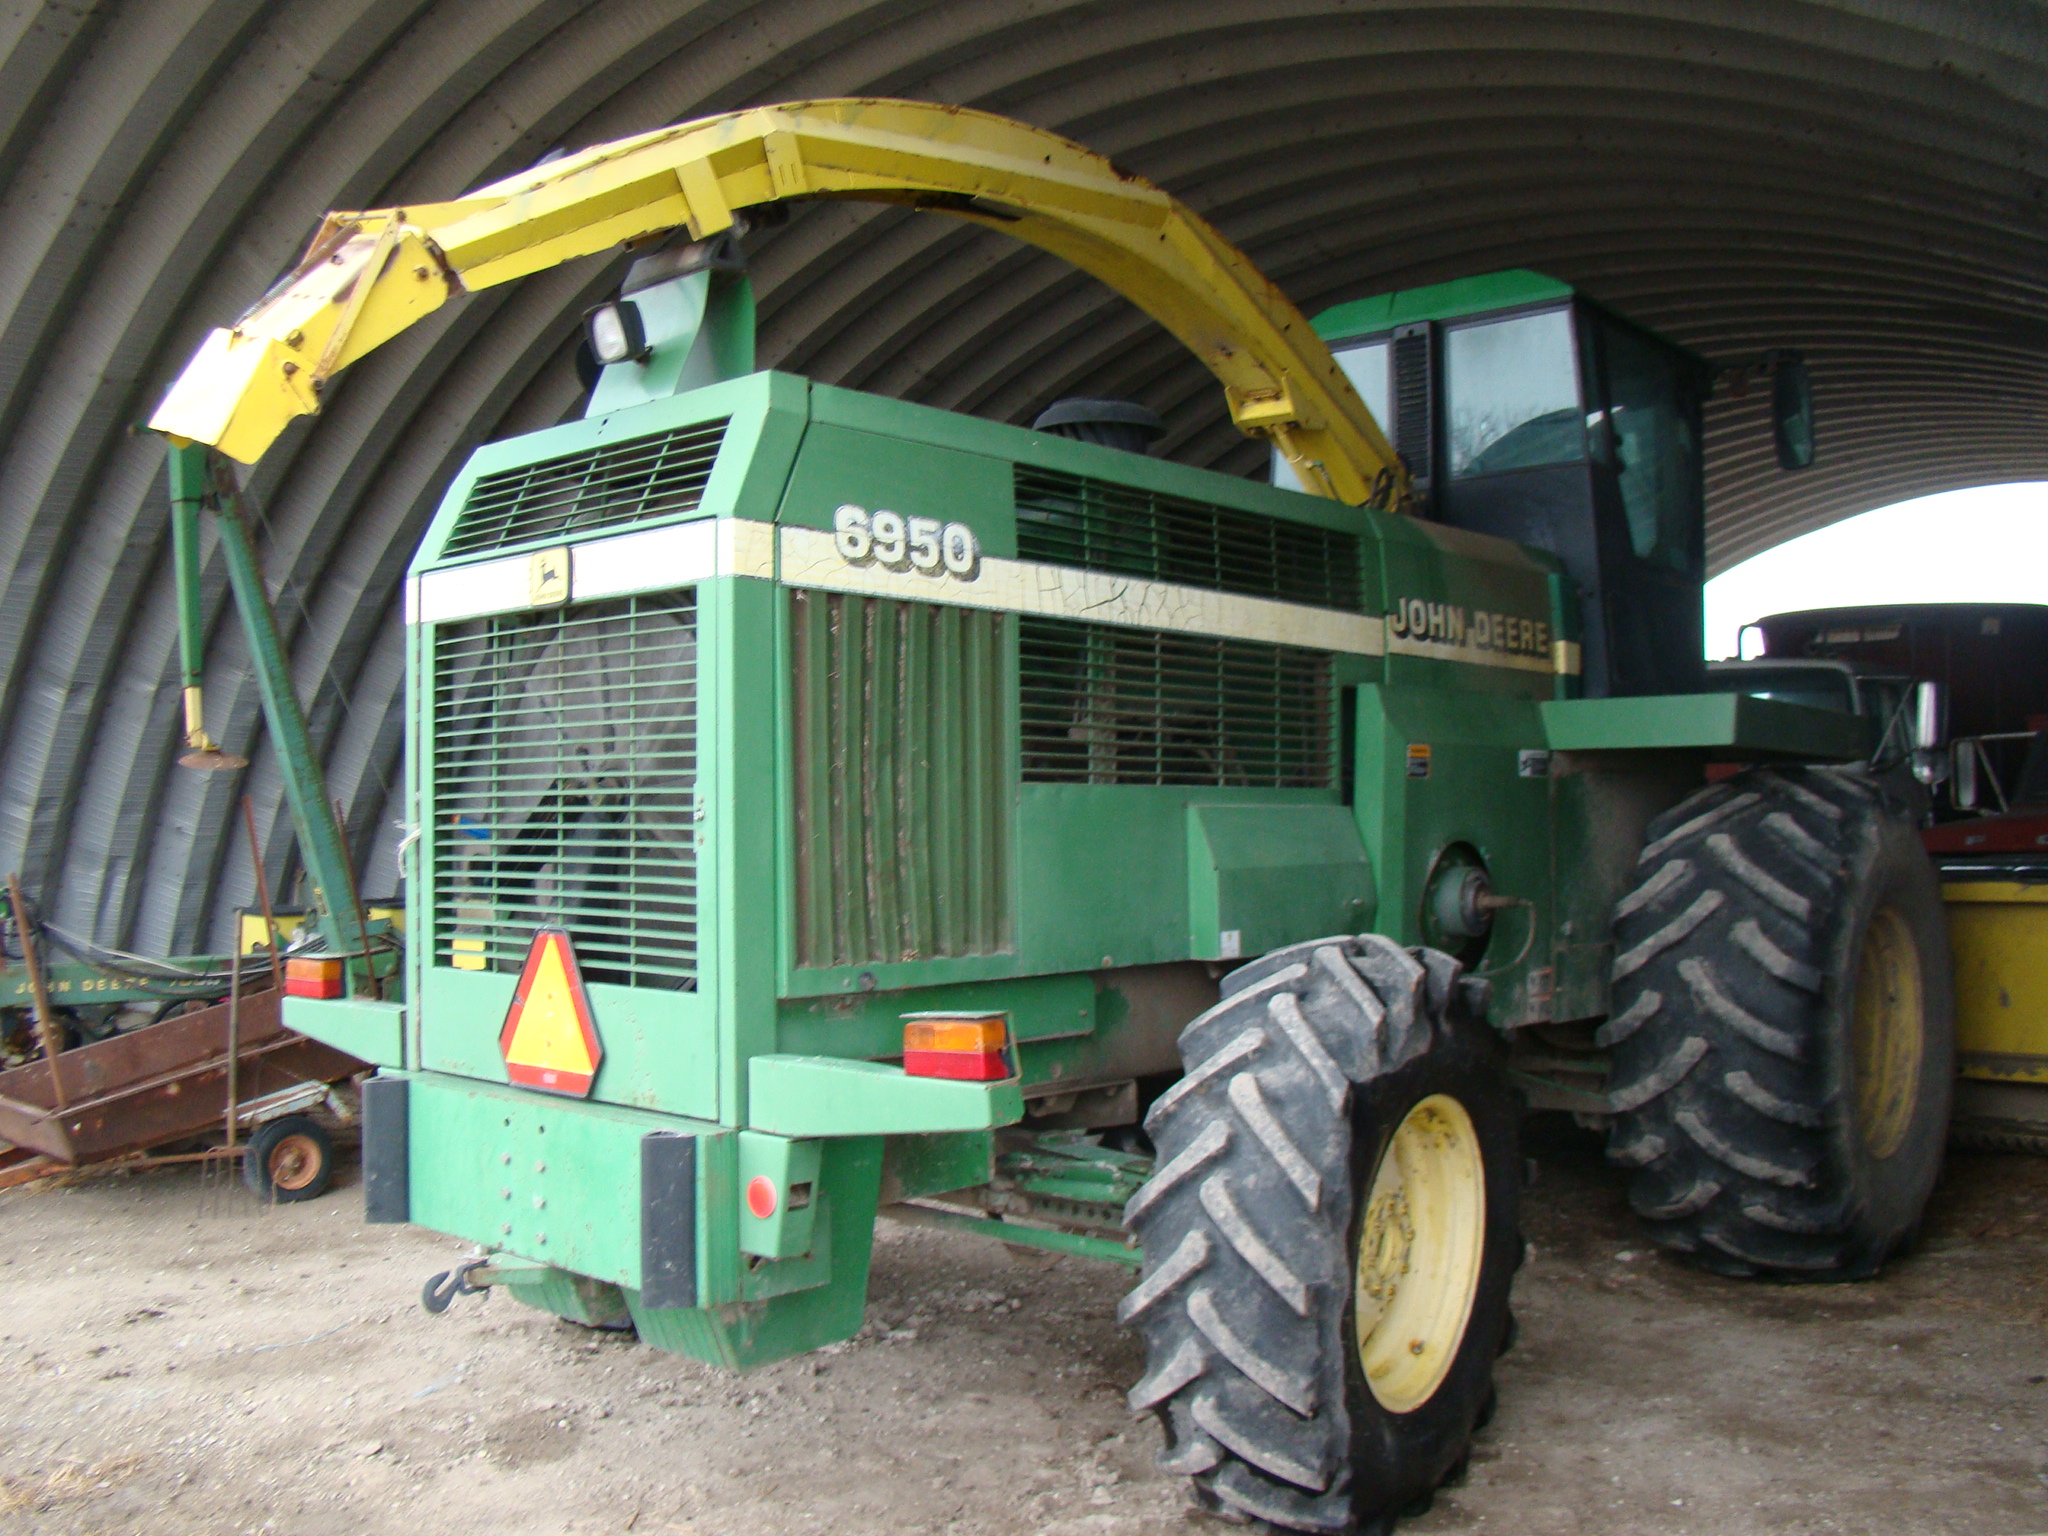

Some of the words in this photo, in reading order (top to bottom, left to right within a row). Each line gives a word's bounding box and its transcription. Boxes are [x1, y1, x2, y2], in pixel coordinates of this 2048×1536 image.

[834, 503, 978, 579] 6950
[1389, 597, 1466, 644] JOHN
[1474, 611, 1550, 653] DEERE
